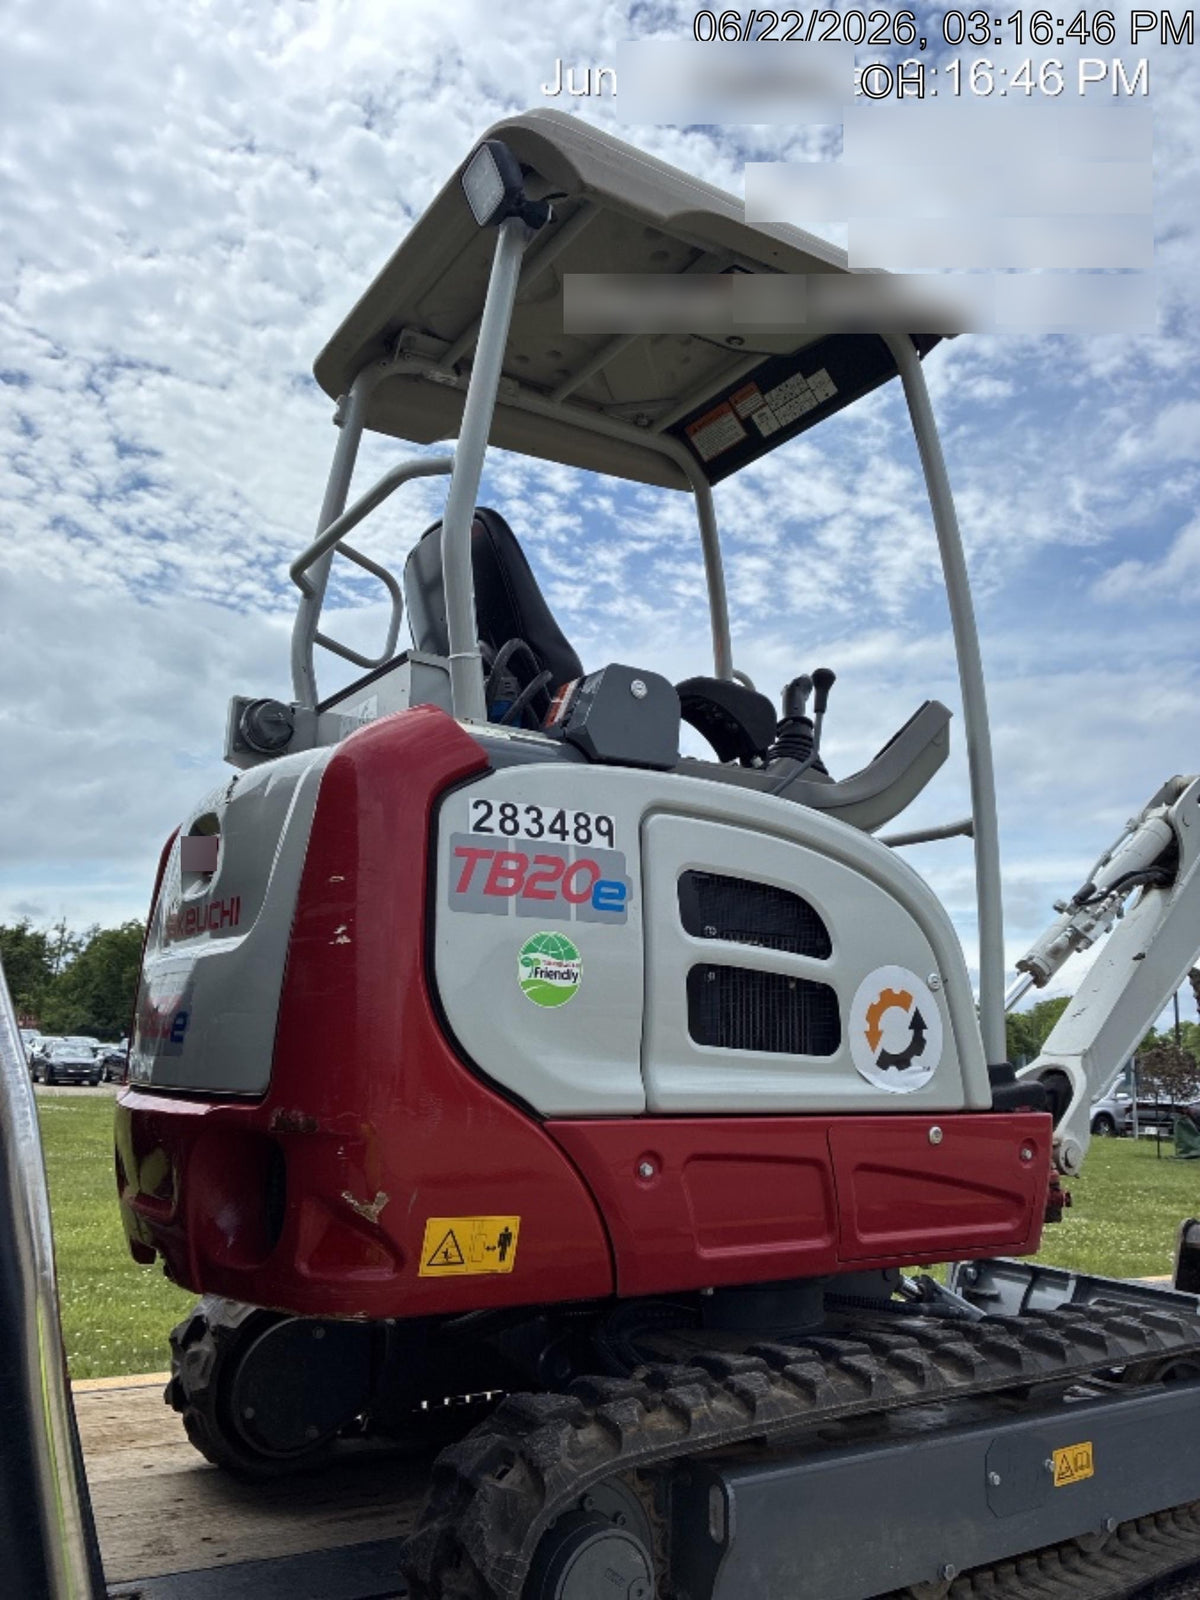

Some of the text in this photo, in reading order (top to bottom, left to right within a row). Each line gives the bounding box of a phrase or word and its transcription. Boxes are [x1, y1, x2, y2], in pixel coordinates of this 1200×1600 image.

[472, 799, 615, 849] 283489
[454, 846, 627, 913] TB20e
[534, 966, 579, 984] Friendly
